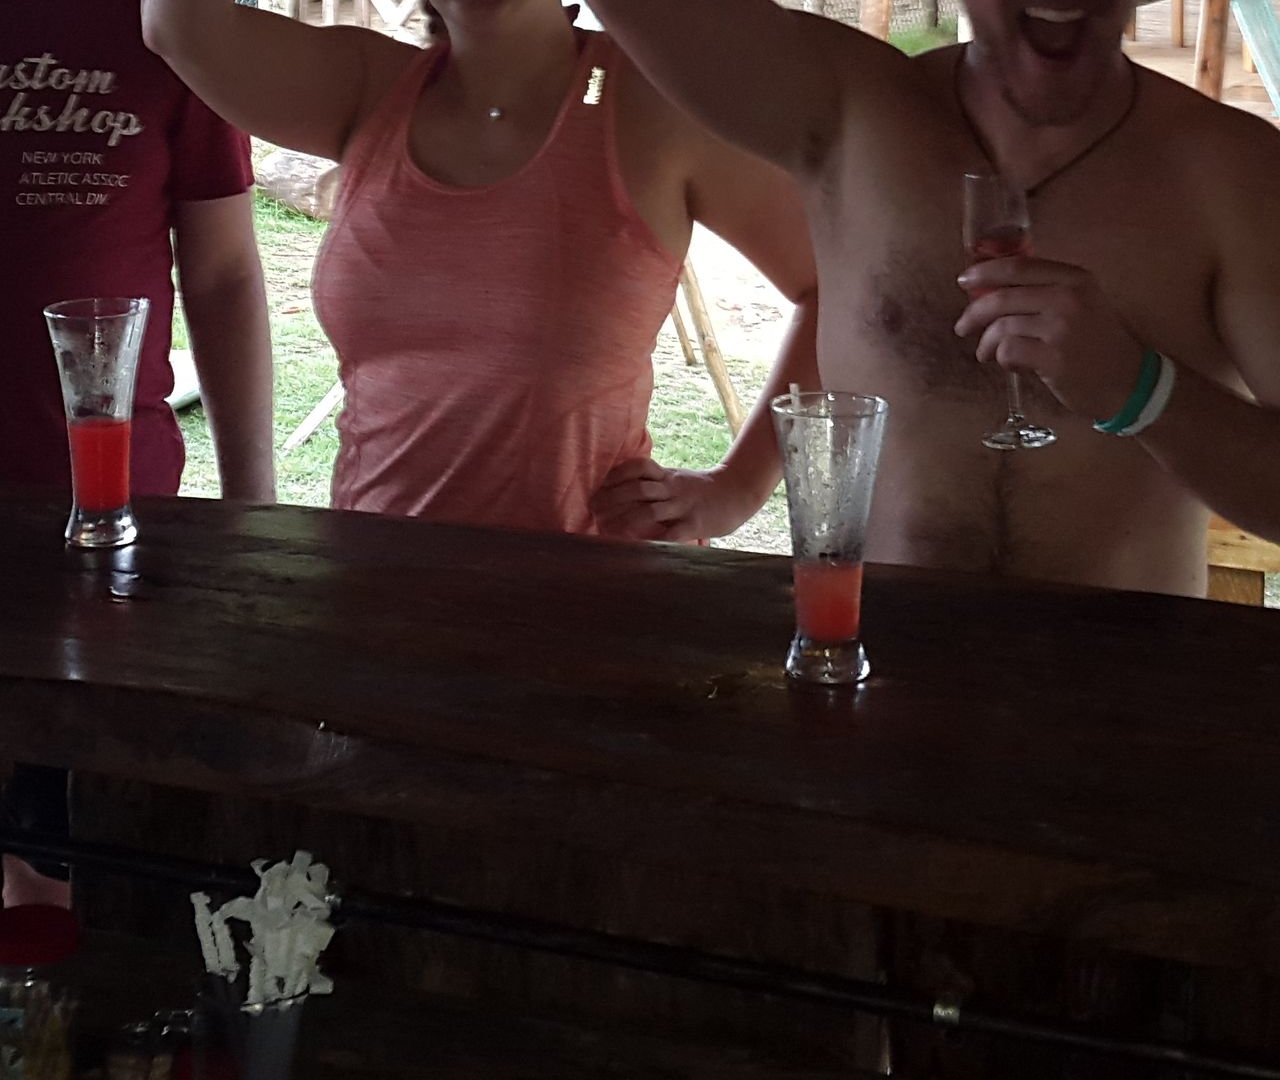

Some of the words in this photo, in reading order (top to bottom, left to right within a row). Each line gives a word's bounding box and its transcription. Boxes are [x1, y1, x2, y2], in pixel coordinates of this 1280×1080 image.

[21, 151, 58, 164] NEW
[61, 151, 103, 165] YORK
[19, 172, 79, 186] ATLETIC
[80, 172, 130, 188] ASSOC
[15, 192, 83, 206] CENTRAL
